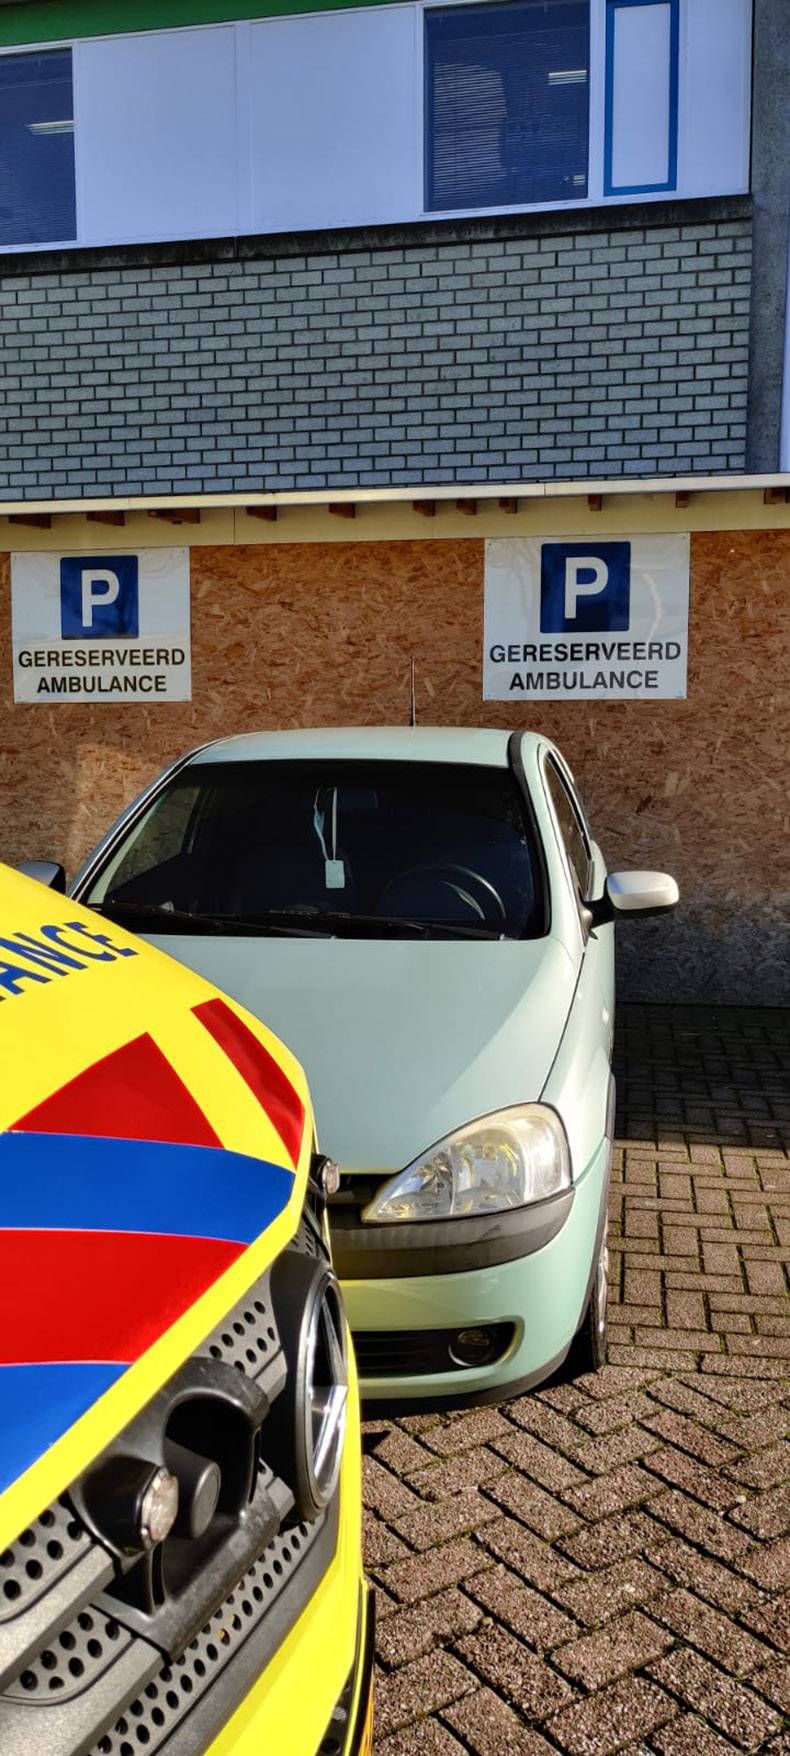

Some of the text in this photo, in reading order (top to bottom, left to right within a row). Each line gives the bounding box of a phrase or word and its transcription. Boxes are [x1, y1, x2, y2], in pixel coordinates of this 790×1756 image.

[81, 569, 120, 627] P
[564, 557, 609, 619] P
[18, 648, 186, 668] GERESERVEERD
[489, 642, 681, 663] GERESERVEERD
[36, 675, 167, 693] AMBULANCE
[509, 671, 659, 690] AMBULANCE
[0, 921, 139, 1001] ANCE
